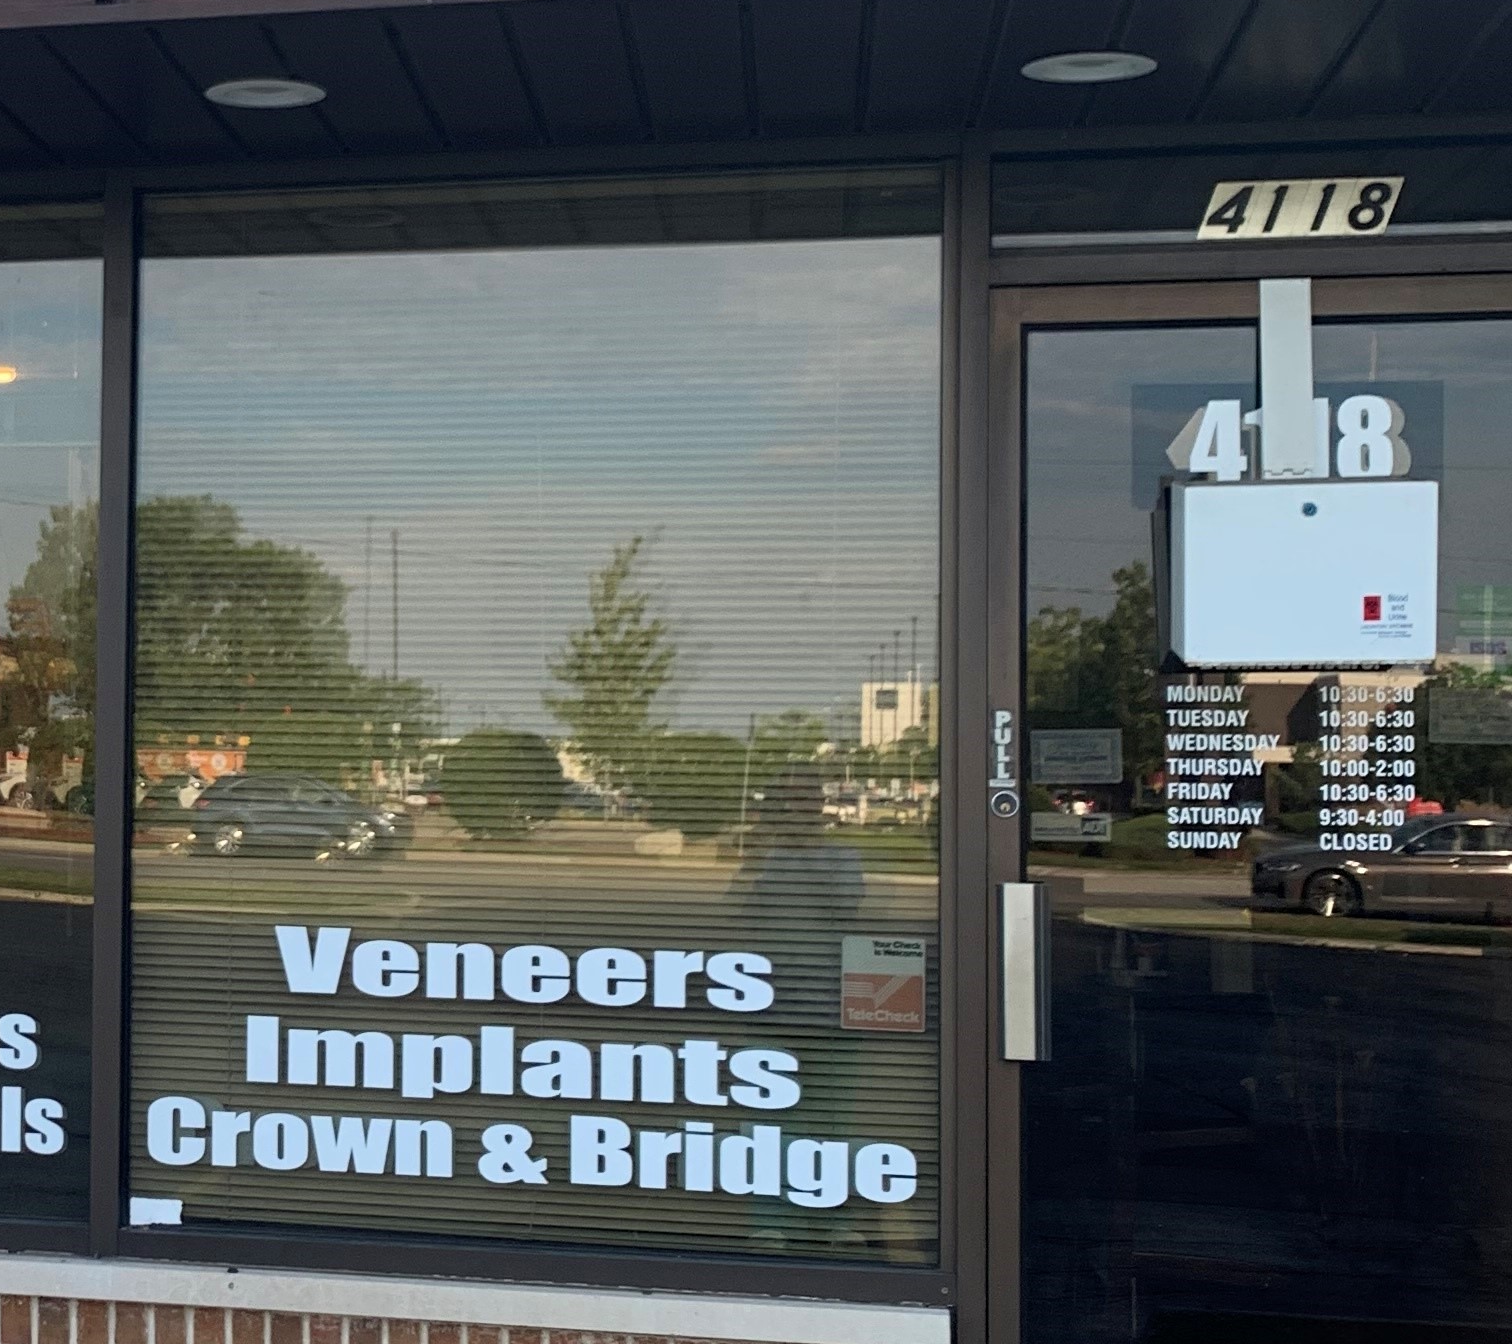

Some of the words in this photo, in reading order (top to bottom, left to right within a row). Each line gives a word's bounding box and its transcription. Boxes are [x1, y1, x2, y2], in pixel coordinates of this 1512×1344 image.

[1206, 182, 1392, 234] 4118
[1167, 685, 1245, 703] MONDAY
[1320, 686, 1415, 704] 10:30-6:30
[1167, 709, 1249, 728] TUESDAY
[1320, 710, 1415, 729] 10:30-6:30
[994, 710, 1011, 779] PULL
[1167, 734, 1280, 752] WEDNESDAY
[1320, 735, 1415, 753] 10:30-6:30
[1167, 758, 1264, 777] THURSDAY
[1320, 759, 1415, 778] 10:00-2:00
[1167, 782, 1233, 801] FRIDAY
[1320, 784, 1415, 802] 10:30-6:30
[1167, 806, 1263, 826] SATURDAY
[1319, 808, 1405, 827] 9:30-4:00
[1167, 831, 1241, 850] SUNDAY
[1319, 833, 1392, 851] CLOSED
[274, 925, 774, 1013] Veneers
[246, 1014, 802, 1110] Implants
[146, 1096, 454, 1179] Crown
[477, 1122, 549, 1186] &
[570, 1114, 919, 1209] Bridge
